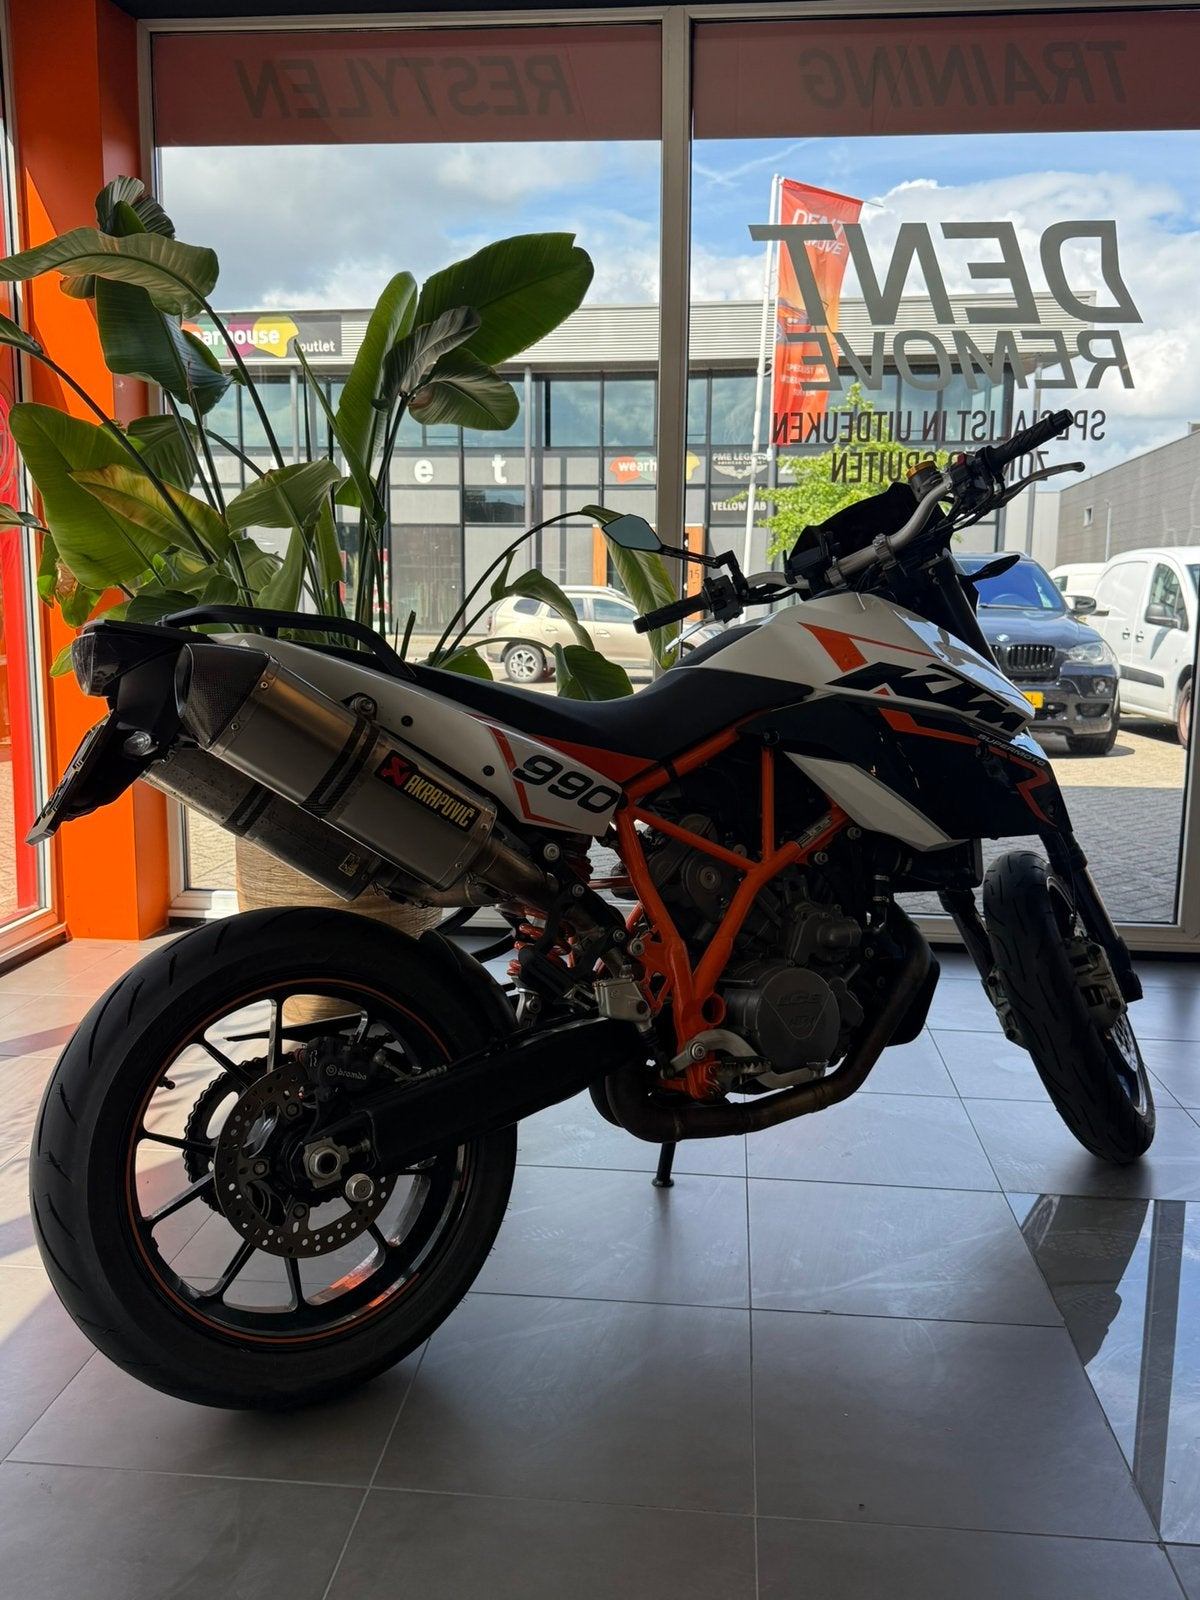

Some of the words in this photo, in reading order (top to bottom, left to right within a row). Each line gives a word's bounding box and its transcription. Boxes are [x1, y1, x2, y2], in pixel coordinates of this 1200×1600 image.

[300, 340, 335, 353] outlet
[618, 459, 657, 472] wearh
[711, 501, 747, 511] YELLOW
[825, 661, 1027, 733] KTM
[977, 733, 1047, 767] SUPERMOTO
[511, 754, 621, 814] 990
